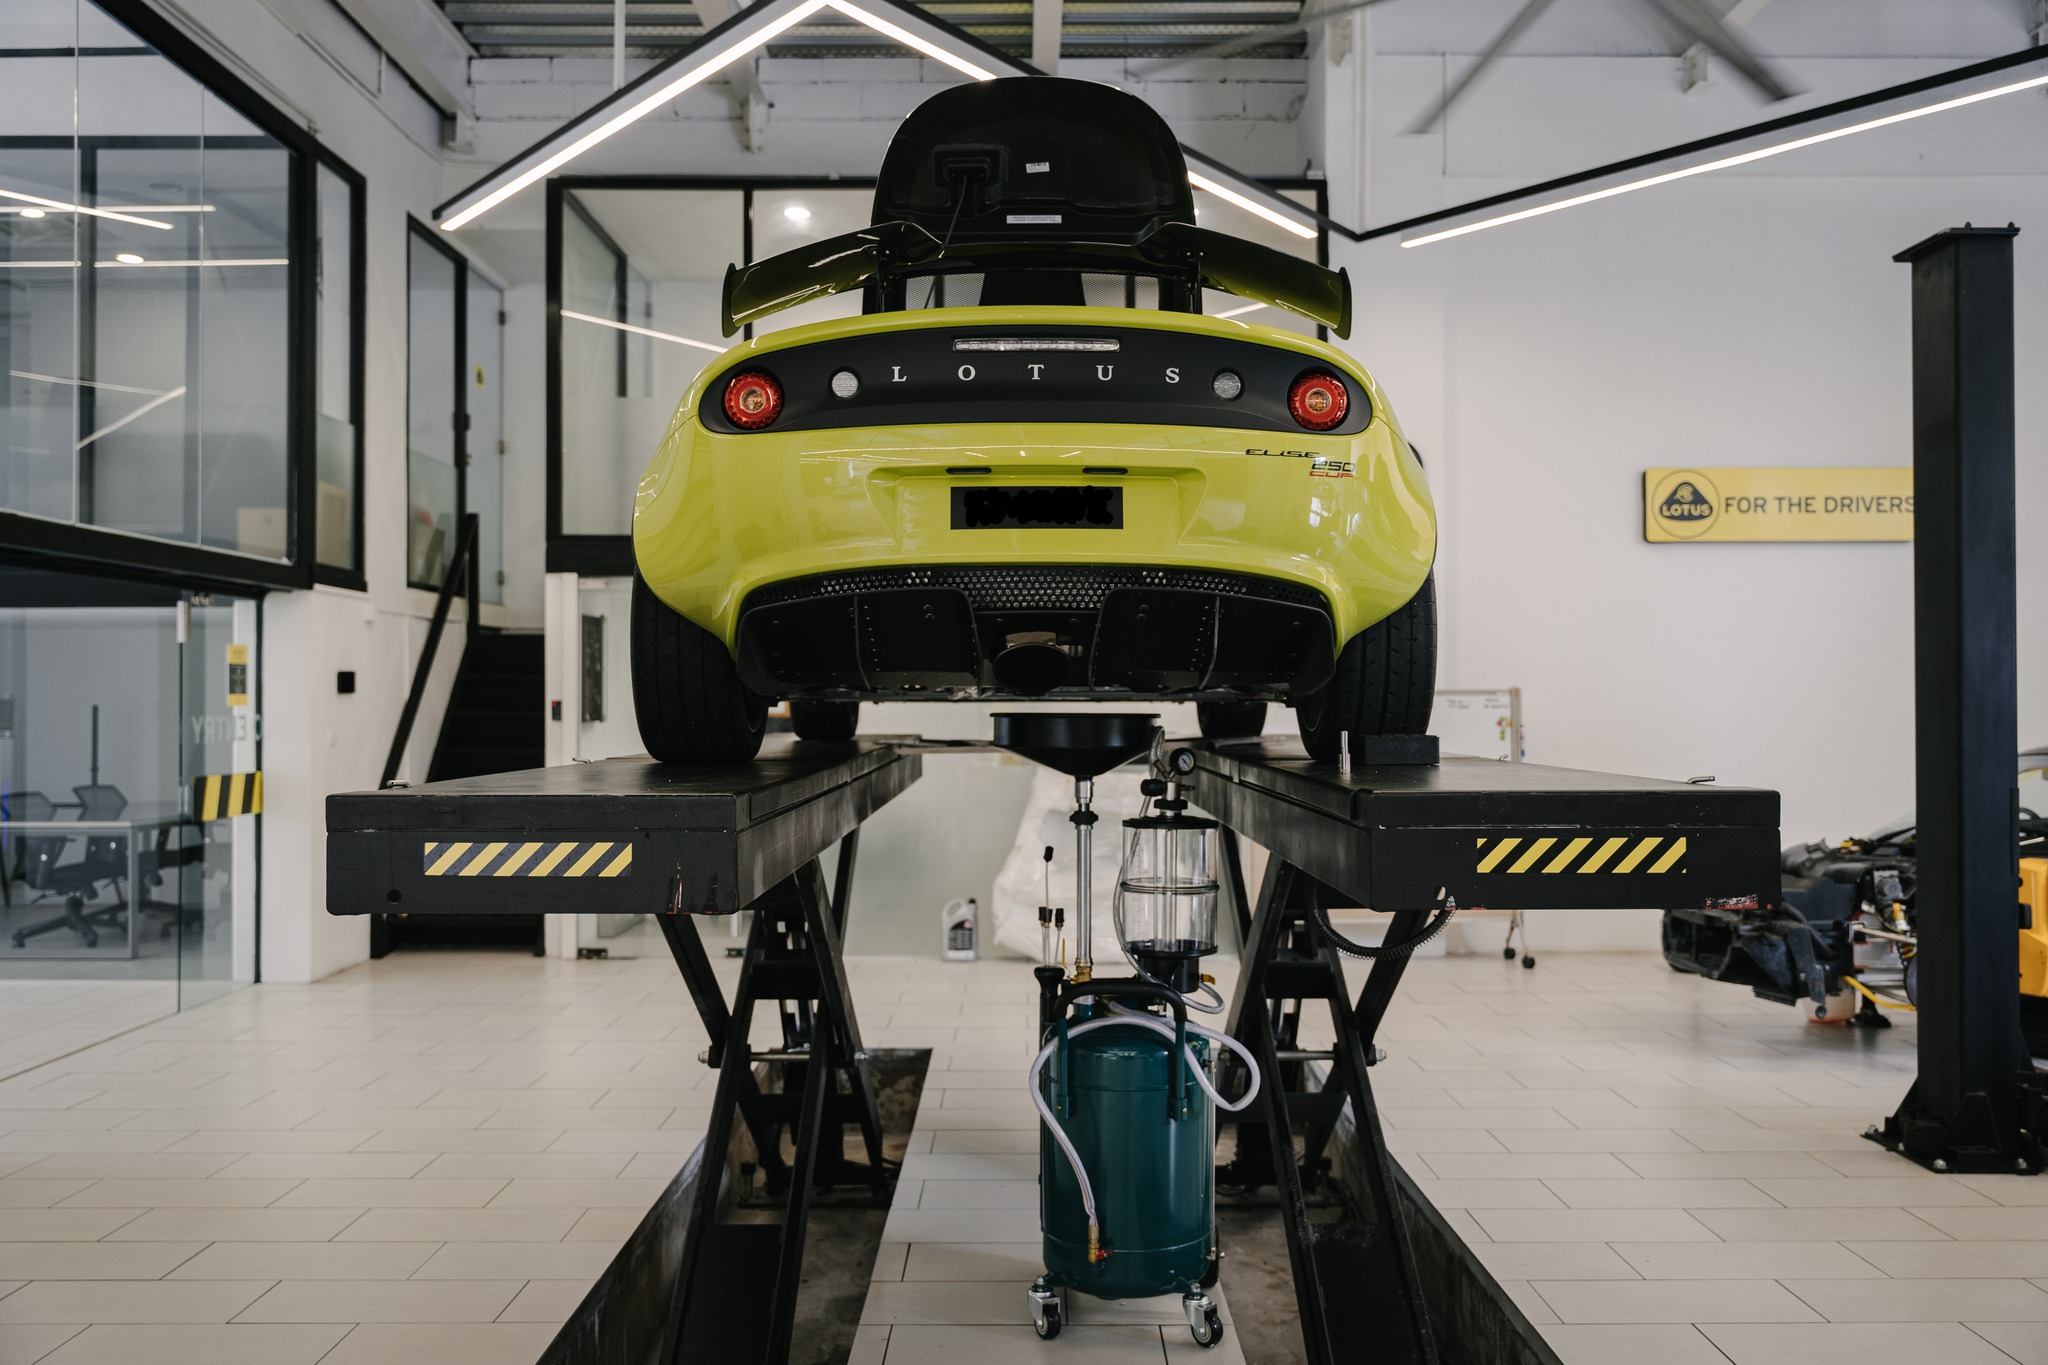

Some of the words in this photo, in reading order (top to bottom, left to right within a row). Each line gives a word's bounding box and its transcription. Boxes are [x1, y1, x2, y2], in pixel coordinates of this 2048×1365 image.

[891, 364, 1180, 384] LOTUS
[1311, 460, 1356, 473] 250
[1309, 470, 1354, 478] CUP
[1661, 503, 1711, 517] LOTUS
[1724, 496, 1768, 515] FOR
[1774, 496, 1817, 514] THE
[1824, 496, 1914, 514] DRIVERS
